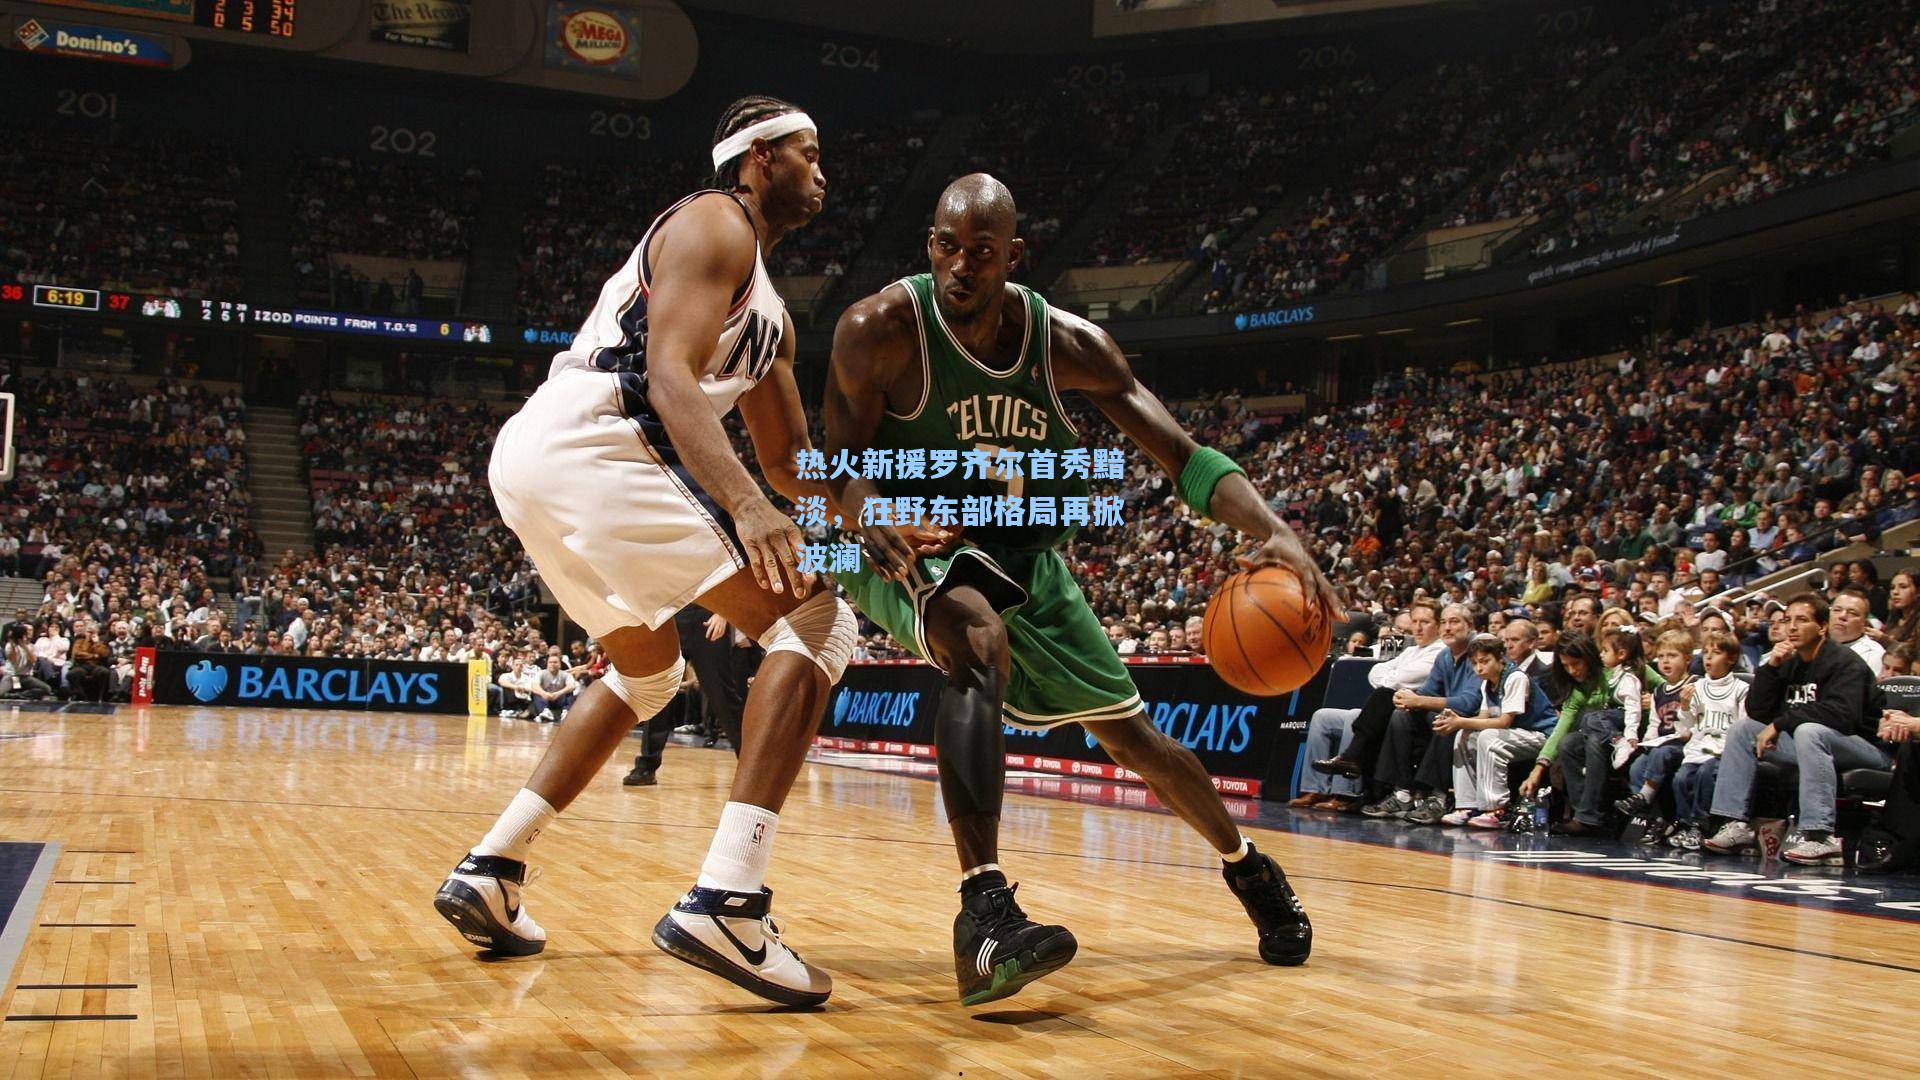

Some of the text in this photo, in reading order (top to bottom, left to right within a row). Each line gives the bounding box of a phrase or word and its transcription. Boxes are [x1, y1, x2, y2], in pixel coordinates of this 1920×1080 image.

[241, 16, 253, 31] 5
[270, 20, 293, 36] 50
[576, 21, 622, 41] MEGA
[56, 30, 138, 56] Domino's
[820, 42, 880, 72] 204
[1298, 44, 1356, 71] 206
[1067, 63, 1126, 89] 205
[57, 88, 117, 119] 201
[590, 111, 651, 140] 203
[370, 126, 436, 156] 202
[2, 285, 23, 299] 36
[47, 290, 84, 305] 6:19
[109, 294, 129, 309] 37
[202, 309, 212, 320] 2
[238, 312, 245, 323] 1
[254, 310, 292, 323] IZOD
[295, 314, 338, 326] POINTS
[344, 318, 377, 330] FROM
[439, 323, 449, 336] 6
[1250, 306, 1313, 328] BARCLAYS
[541, 330, 577, 344] BARC
[716, 309, 780, 380] NE
[238, 666, 438, 705] BARCLAYS
[1876, 684, 1914, 692] ARQUIS
[847, 692, 920, 726] BARCLAYS
[1143, 702, 1257, 752] RCLAYS
[1280, 721, 1307, 729] MARQUIS
[1697, 709, 1733, 732] CLTICS
[1042, 759, 1061, 770] TOYOTA
[1081, 764, 1103, 775] TOYOTA
[1223, 780, 1249, 792] TOYOTA
